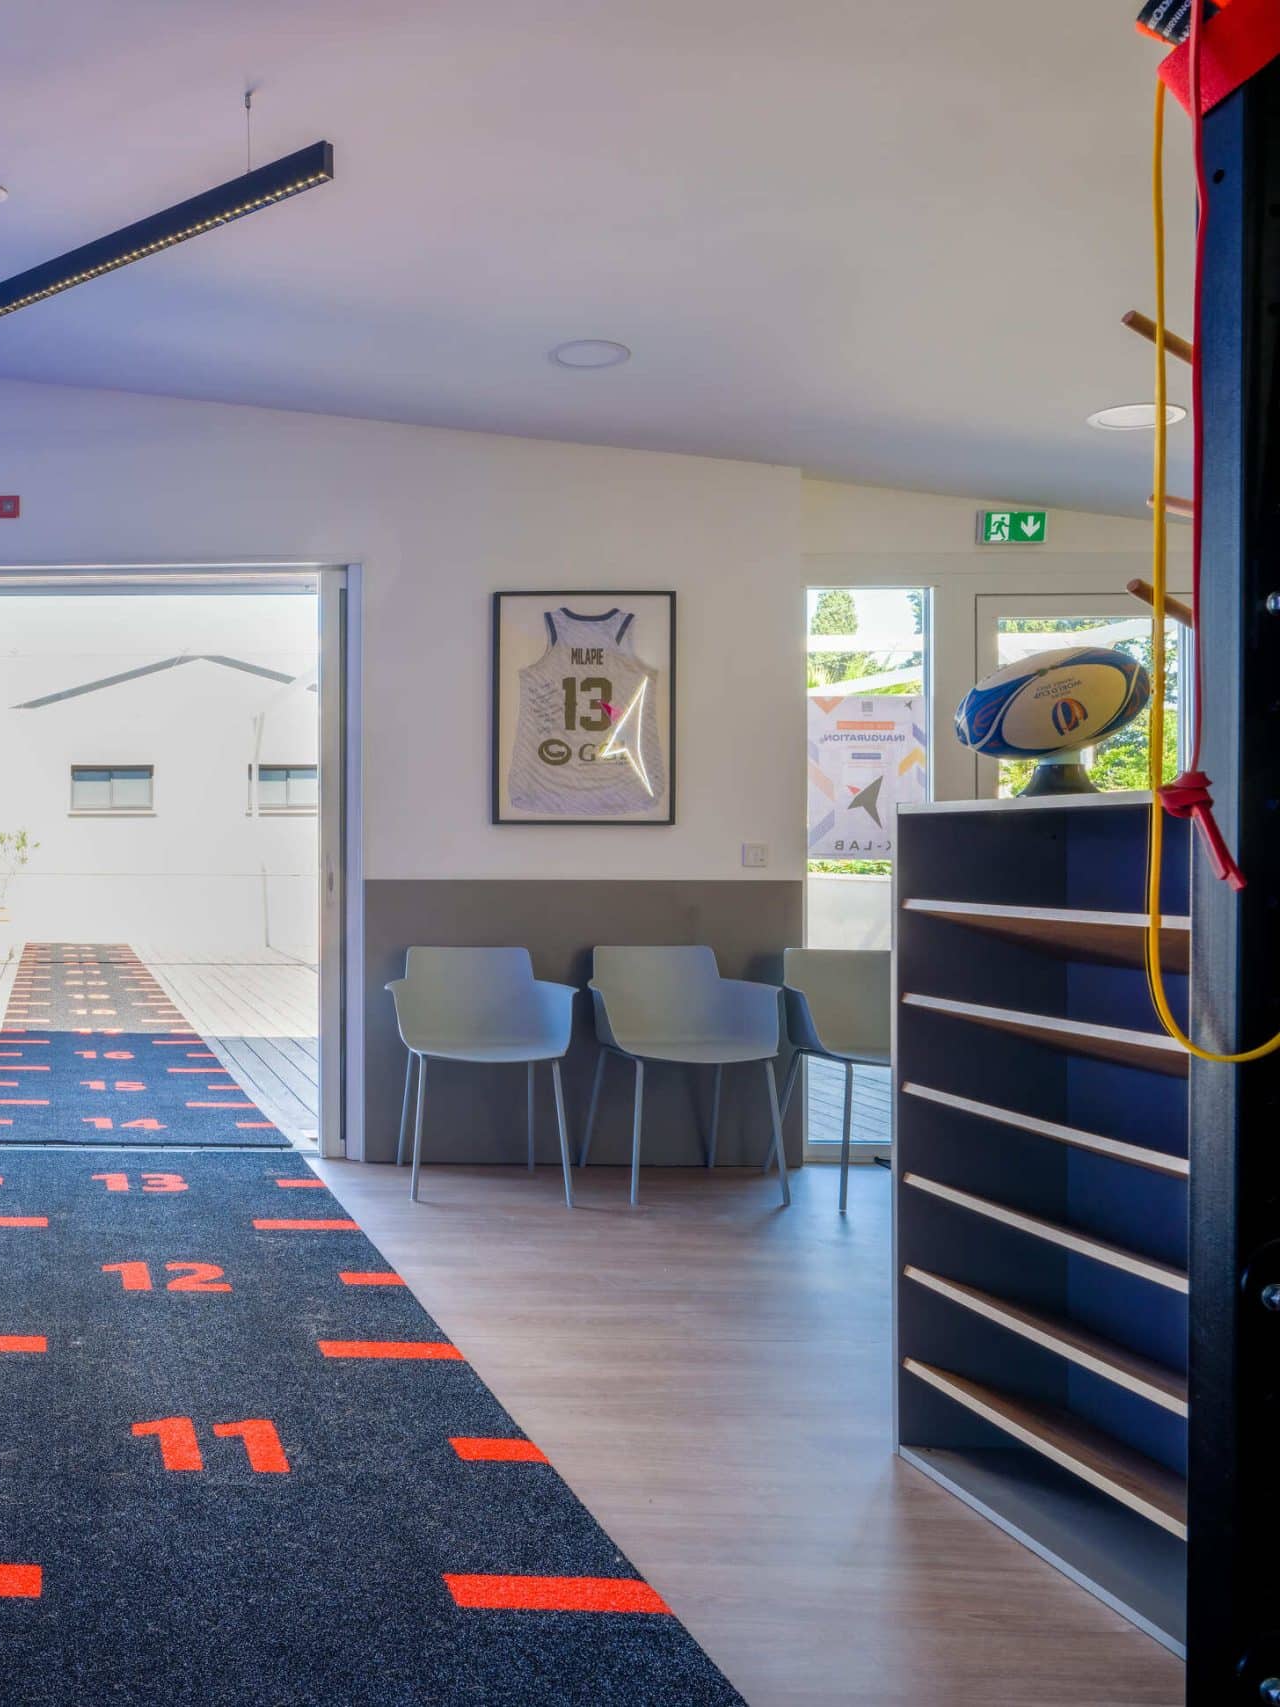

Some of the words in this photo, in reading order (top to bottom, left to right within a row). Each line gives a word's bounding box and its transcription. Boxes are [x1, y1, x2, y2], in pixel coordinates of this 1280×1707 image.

[571, 648, 604, 665] MILAPIE
[562, 677, 612, 732] 13
[74, 1051, 135, 1059] 16
[80, 1080, 147, 1091] 15
[81, 1117, 168, 1130] 14
[91, 1173, 189, 1192] 13
[101, 1261, 233, 1292] 12
[131, 1416, 291, 1473] 11
